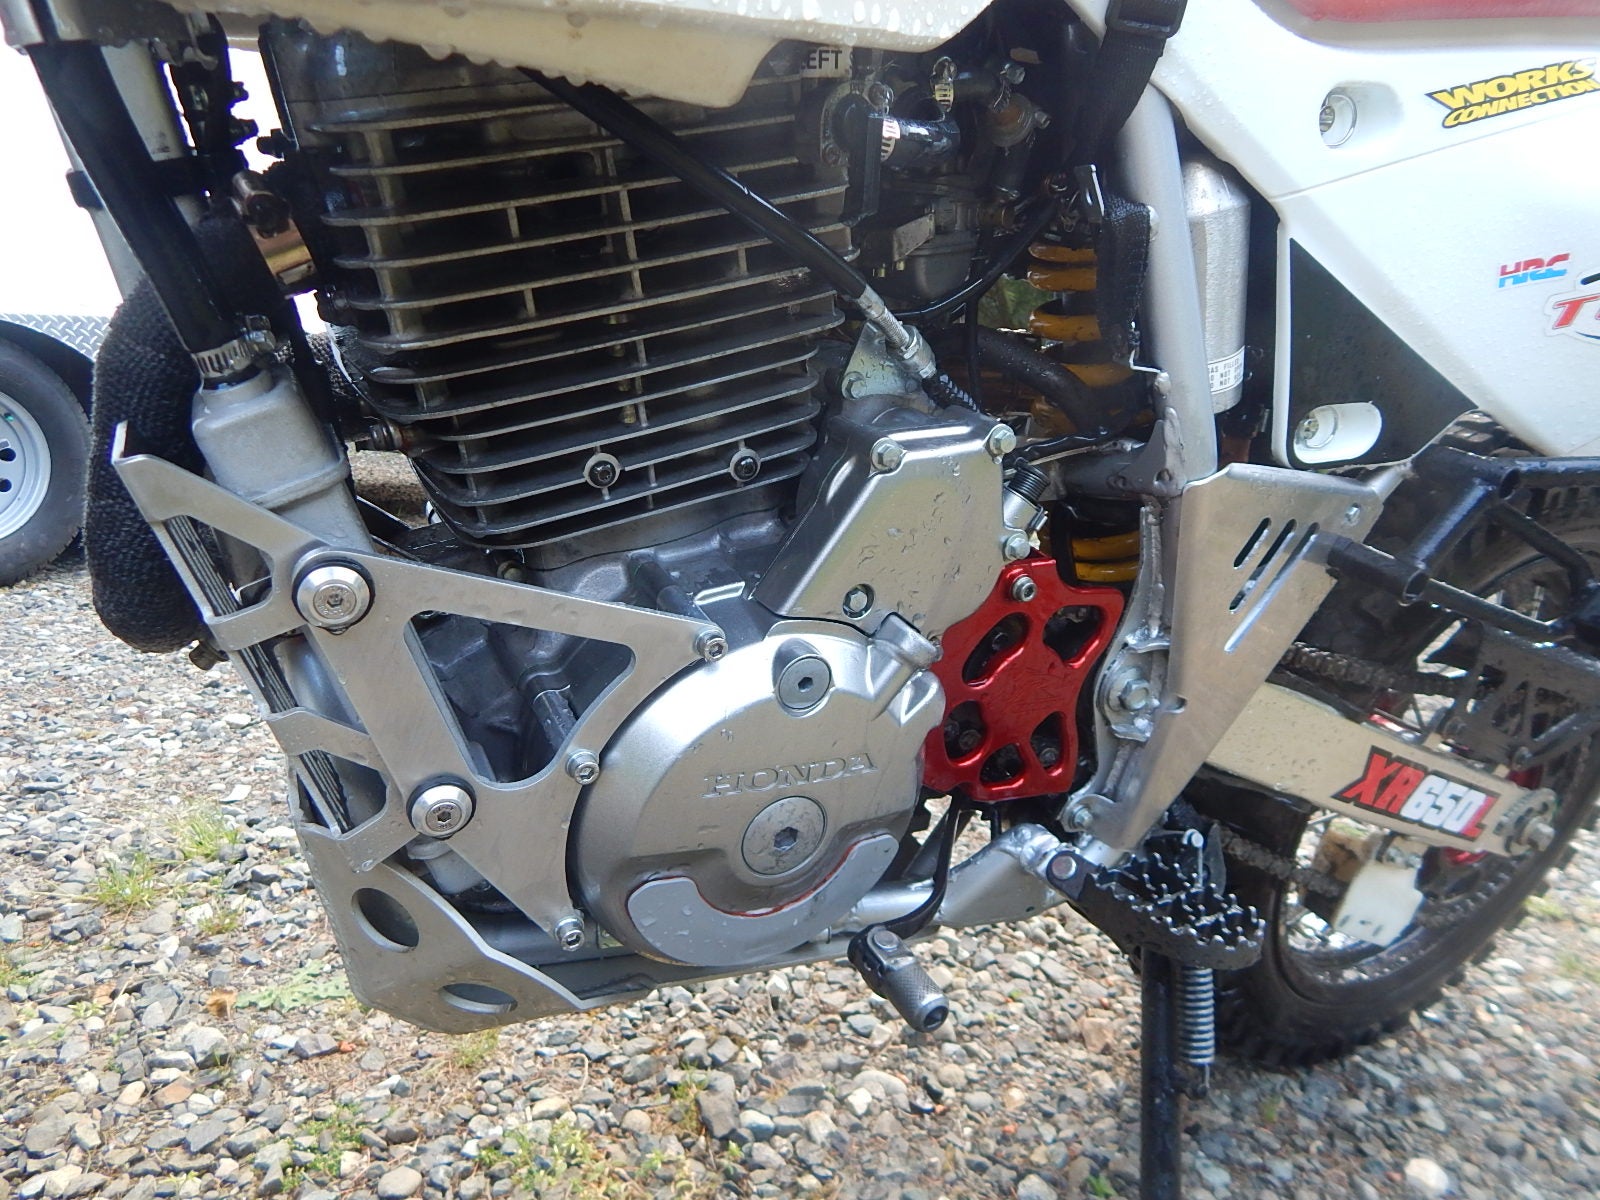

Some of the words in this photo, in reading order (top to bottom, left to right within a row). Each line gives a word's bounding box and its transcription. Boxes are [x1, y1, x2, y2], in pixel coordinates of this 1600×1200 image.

[801, 49, 843, 70] EFT
[1425, 57, 1597, 110] WORKS
[1442, 78, 1600, 129] CONNECTION
[1498, 253, 1570, 288] HRC
[702, 752, 879, 798] HONDA
[1334, 747, 1501, 840] XR650L
